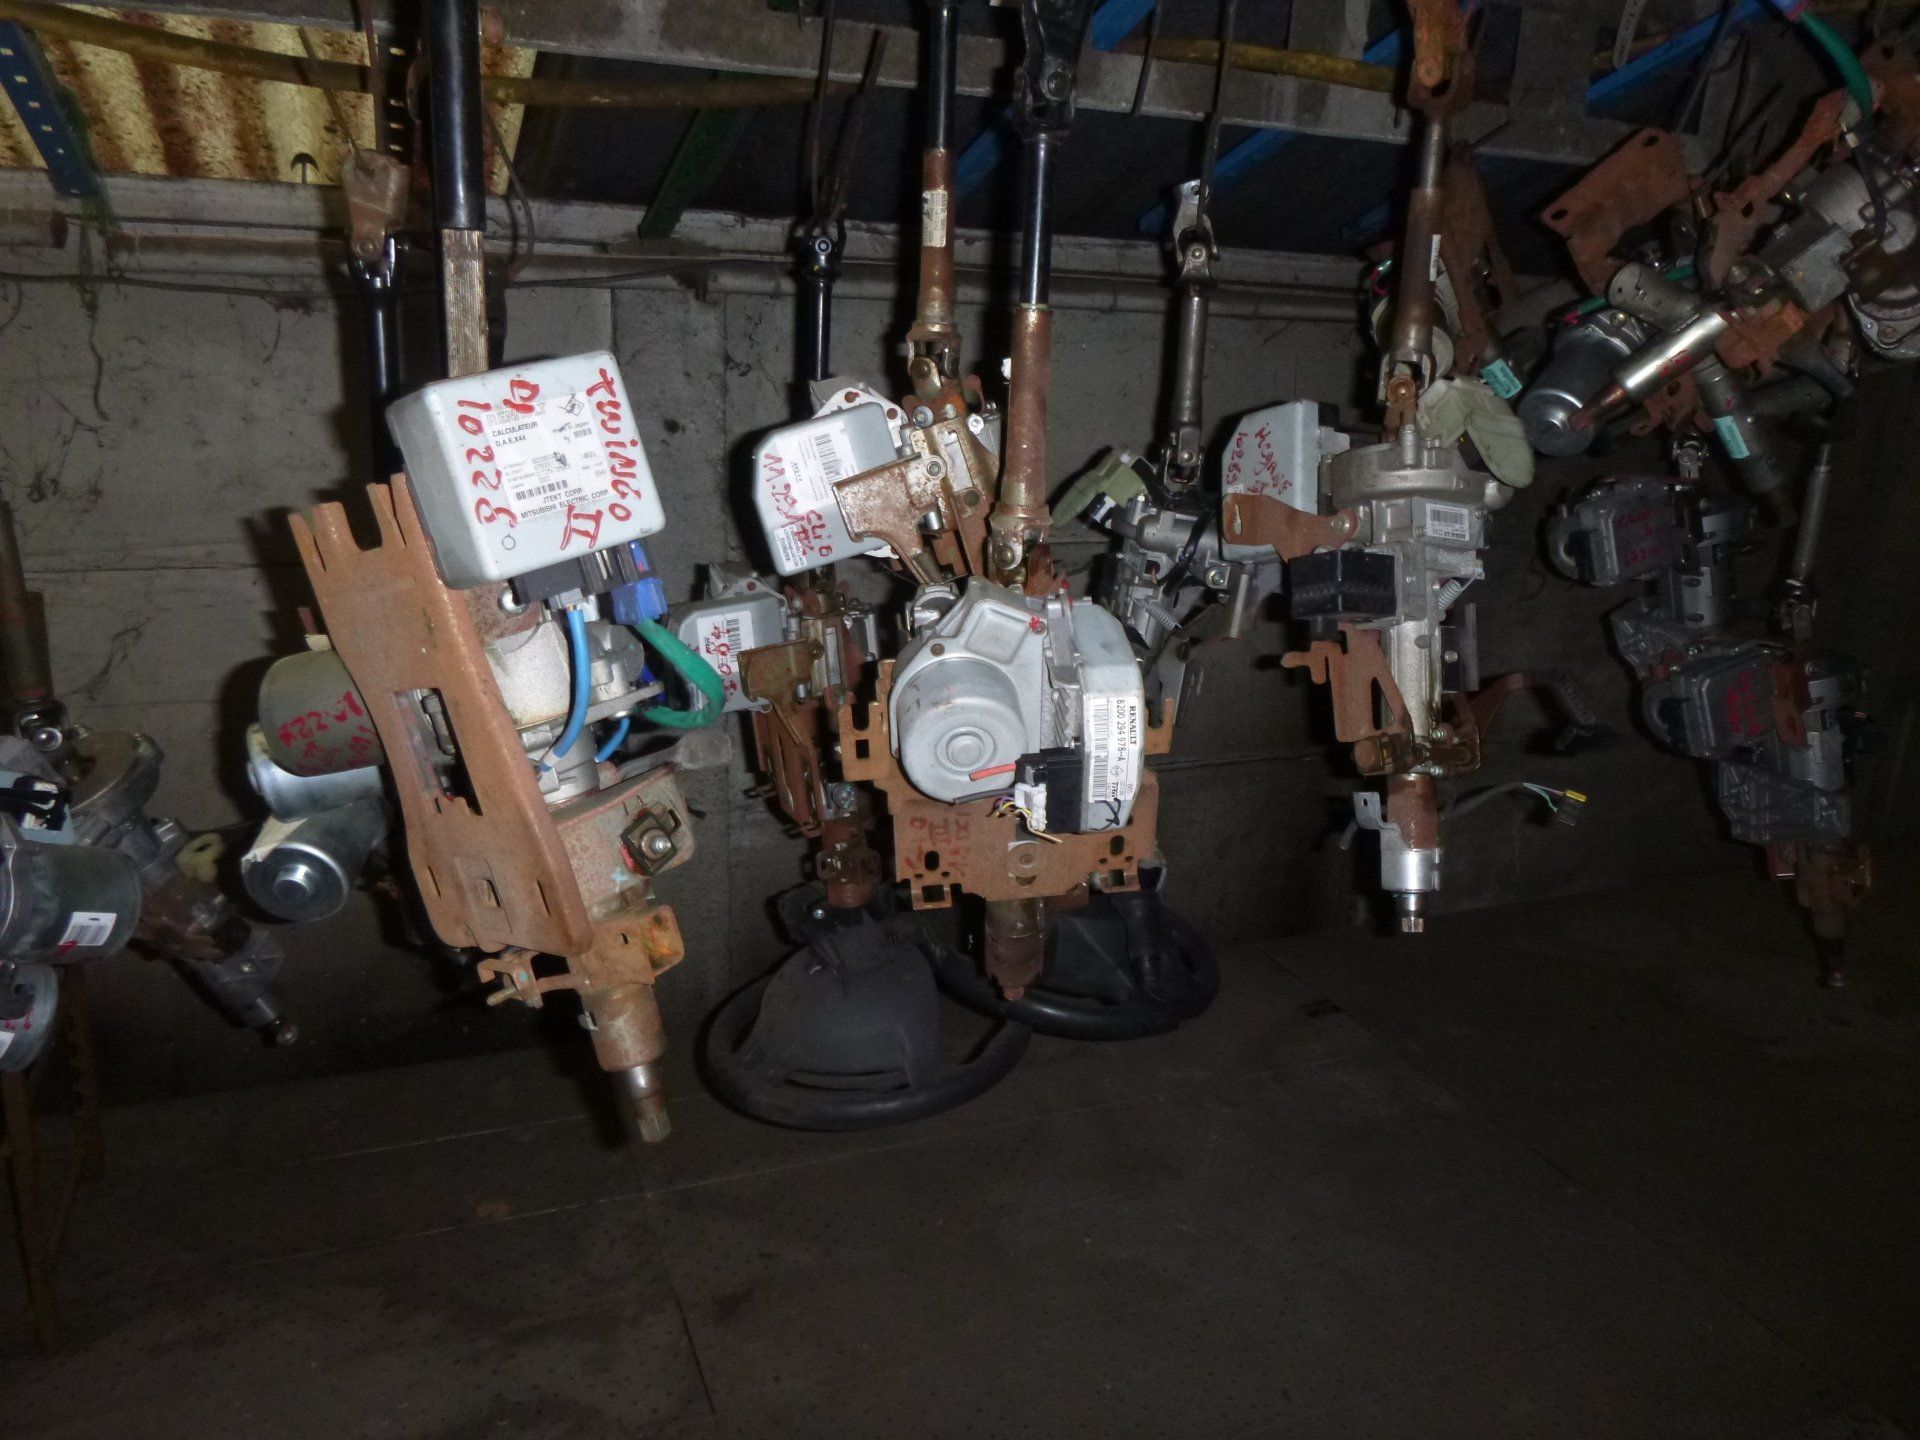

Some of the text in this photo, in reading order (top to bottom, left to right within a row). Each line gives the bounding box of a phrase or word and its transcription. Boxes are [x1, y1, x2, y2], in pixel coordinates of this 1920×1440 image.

[492, 421, 538, 437] CALCULATEUR
[521, 503, 557, 519] MITSUBISHI
[559, 494, 589, 509] ELECTRIC
[543, 492, 562, 504] JTEKT
[1117, 700, 1126, 719] 8200
[1117, 720, 1126, 737] 294
[1130, 706, 1138, 746] RENAULT
[1117, 738, 1128, 762] 978-A
